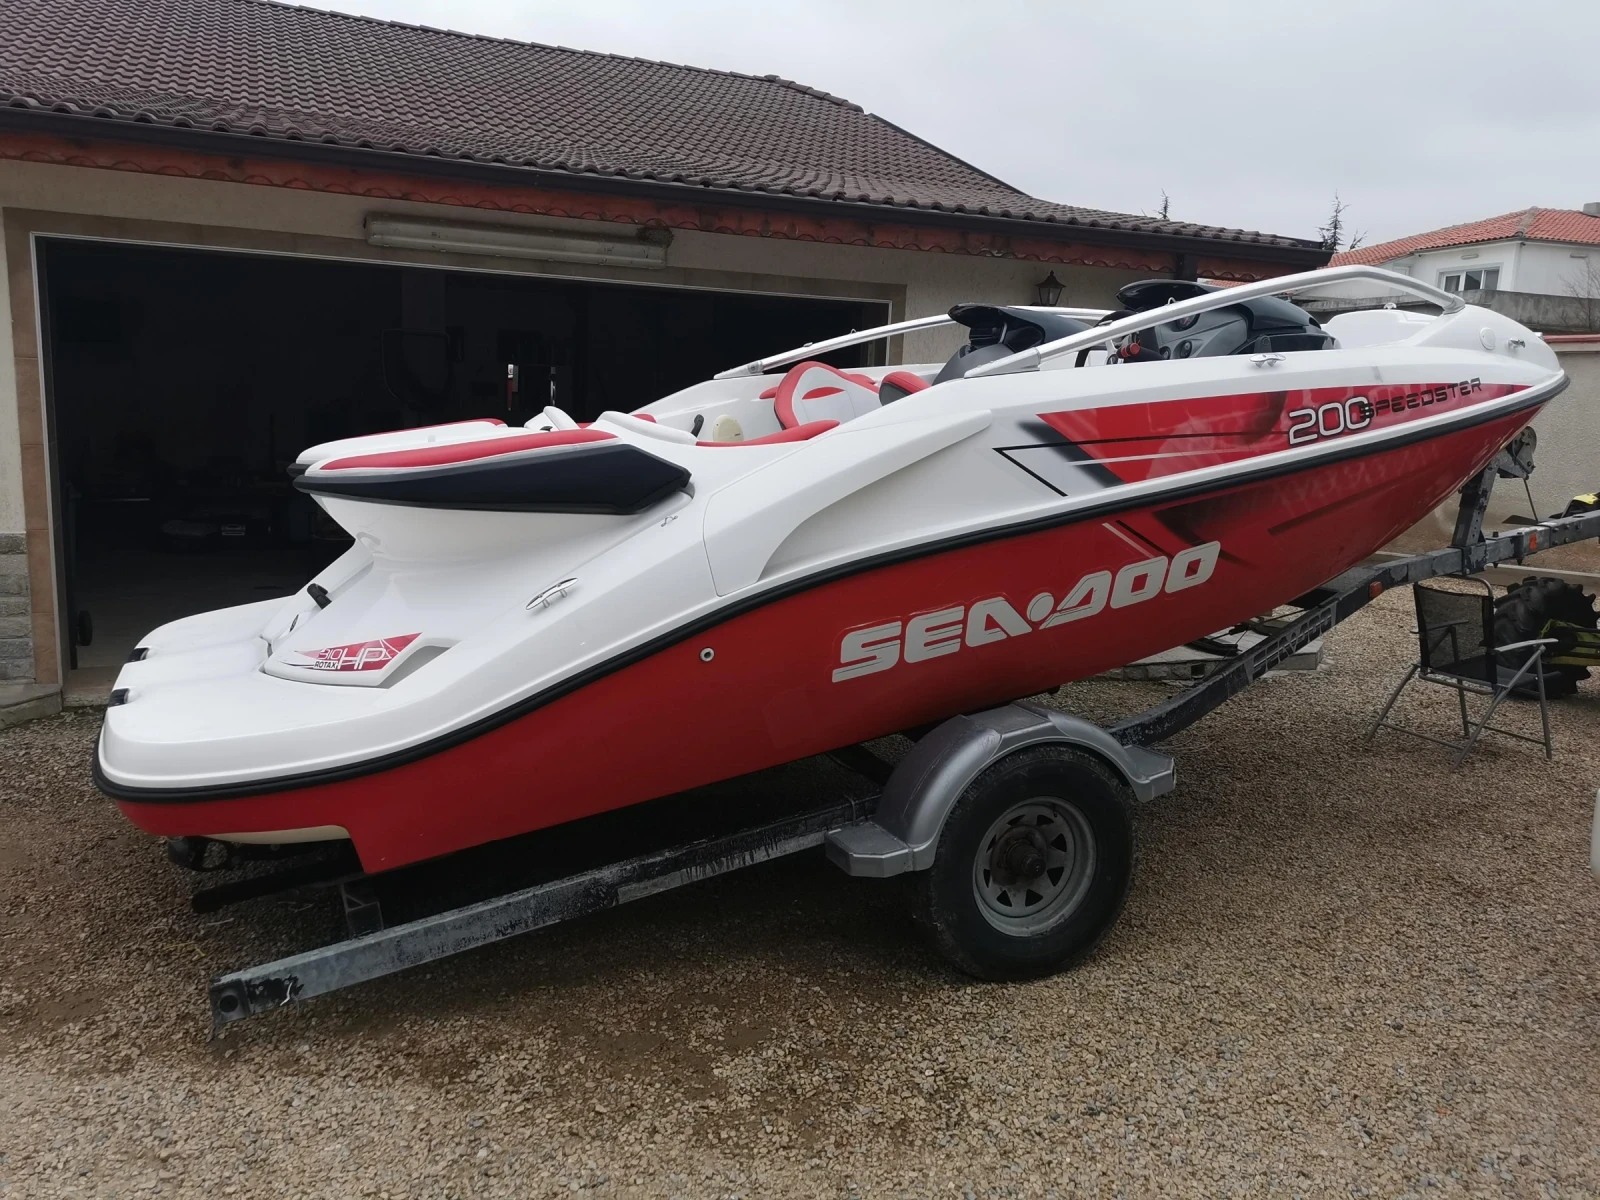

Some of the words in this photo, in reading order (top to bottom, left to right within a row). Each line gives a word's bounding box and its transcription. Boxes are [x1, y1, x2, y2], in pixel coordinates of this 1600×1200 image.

[1288, 395, 1371, 445] 200
[1360, 377, 1482, 420] SPEEDSTER
[314, 661, 337, 669] ROTAX
[337, 648, 386, 670] HP
